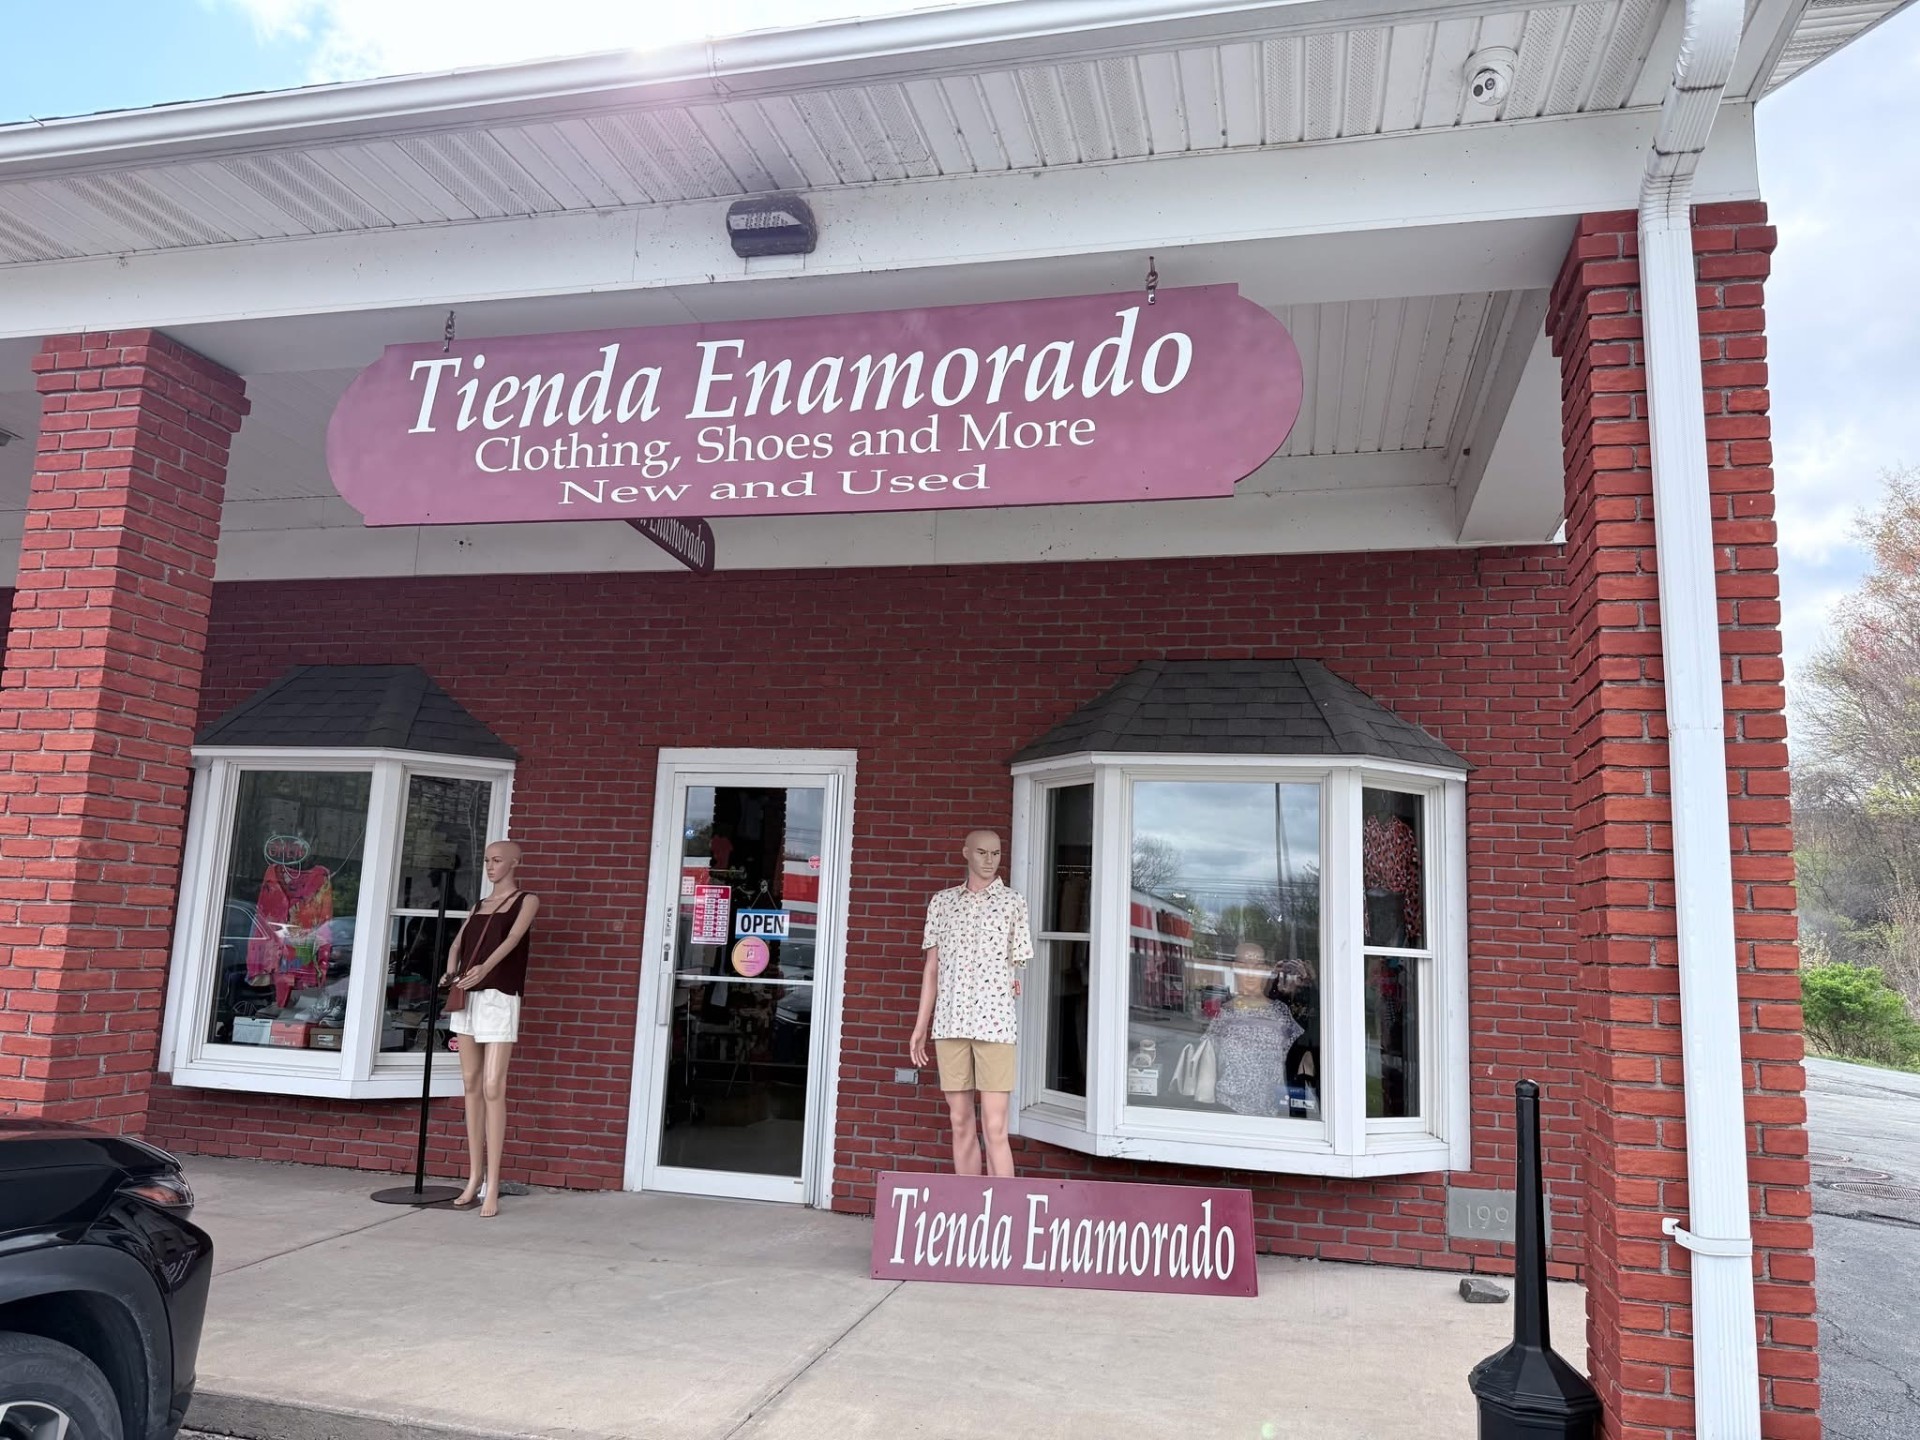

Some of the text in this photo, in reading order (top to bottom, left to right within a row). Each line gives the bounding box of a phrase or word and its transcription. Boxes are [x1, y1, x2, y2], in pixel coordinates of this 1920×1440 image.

[407, 306, 1193, 434] Tienda Enamorado
[475, 411, 1096, 479] Clothing, Shoes and More
[558, 463, 991, 505] New and Used
[740, 914, 785, 934] OPEN
[889, 1187, 1236, 1281] Tienda Enamorado
[1465, 1202, 1510, 1231] 199
